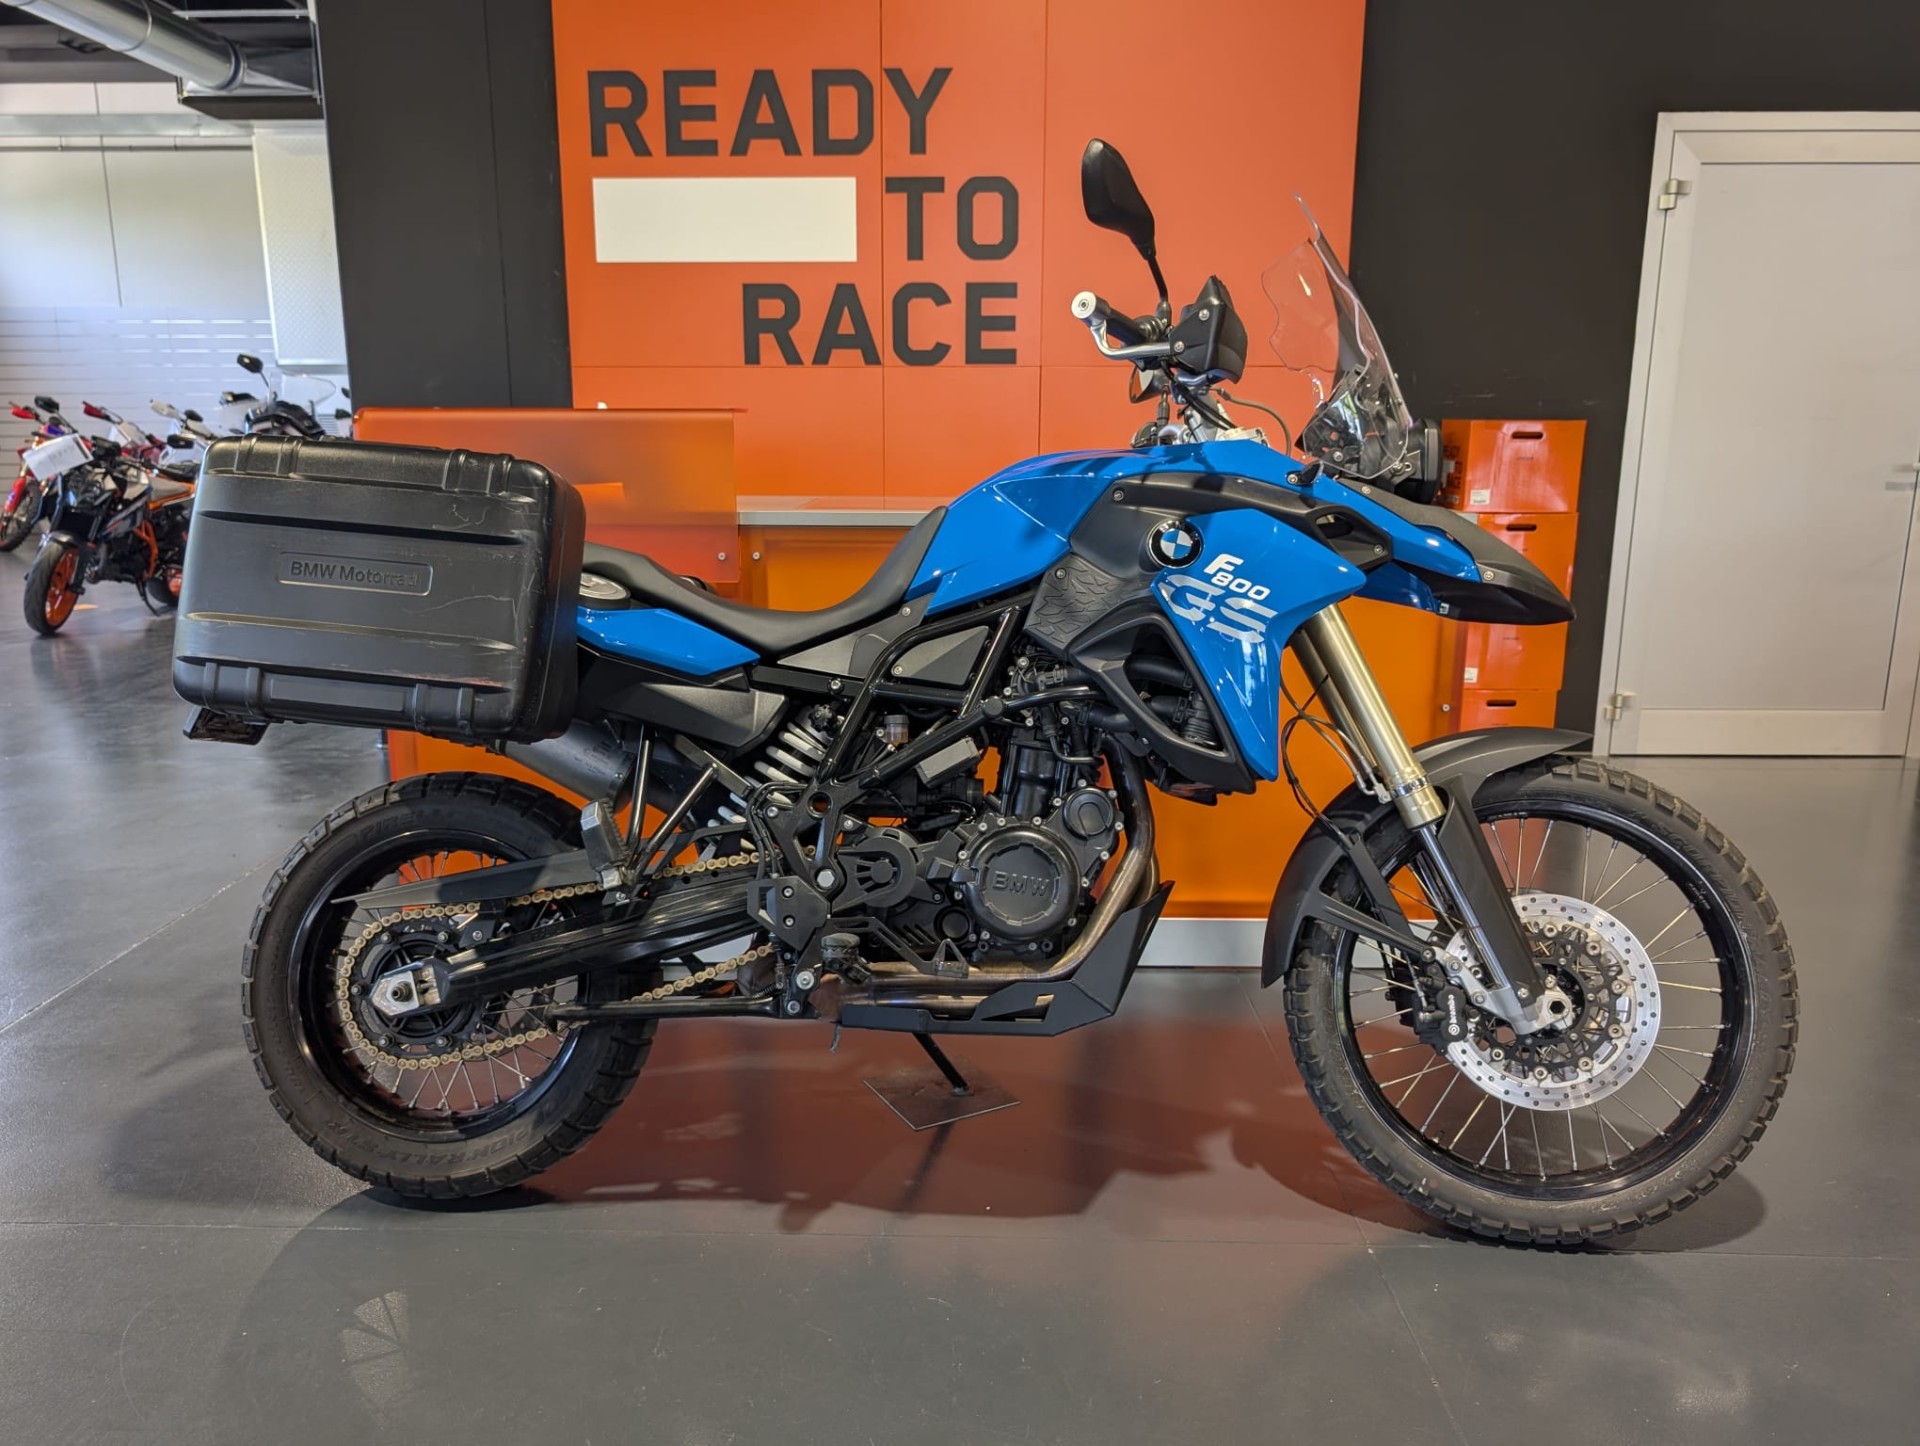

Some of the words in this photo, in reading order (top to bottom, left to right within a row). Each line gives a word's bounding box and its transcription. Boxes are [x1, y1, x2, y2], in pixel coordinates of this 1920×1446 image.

[587, 68, 954, 157] READY
[885, 176, 1019, 261] TO
[742, 282, 1018, 366] RACE
[290, 560, 337, 579] BMW
[339, 565, 418, 587] Motorrad
[1203, 553, 1244, 575] F
[1210, 571, 1271, 601] 800
[1157, 574, 1279, 643] GS
[992, 870, 1050, 896] BMW
